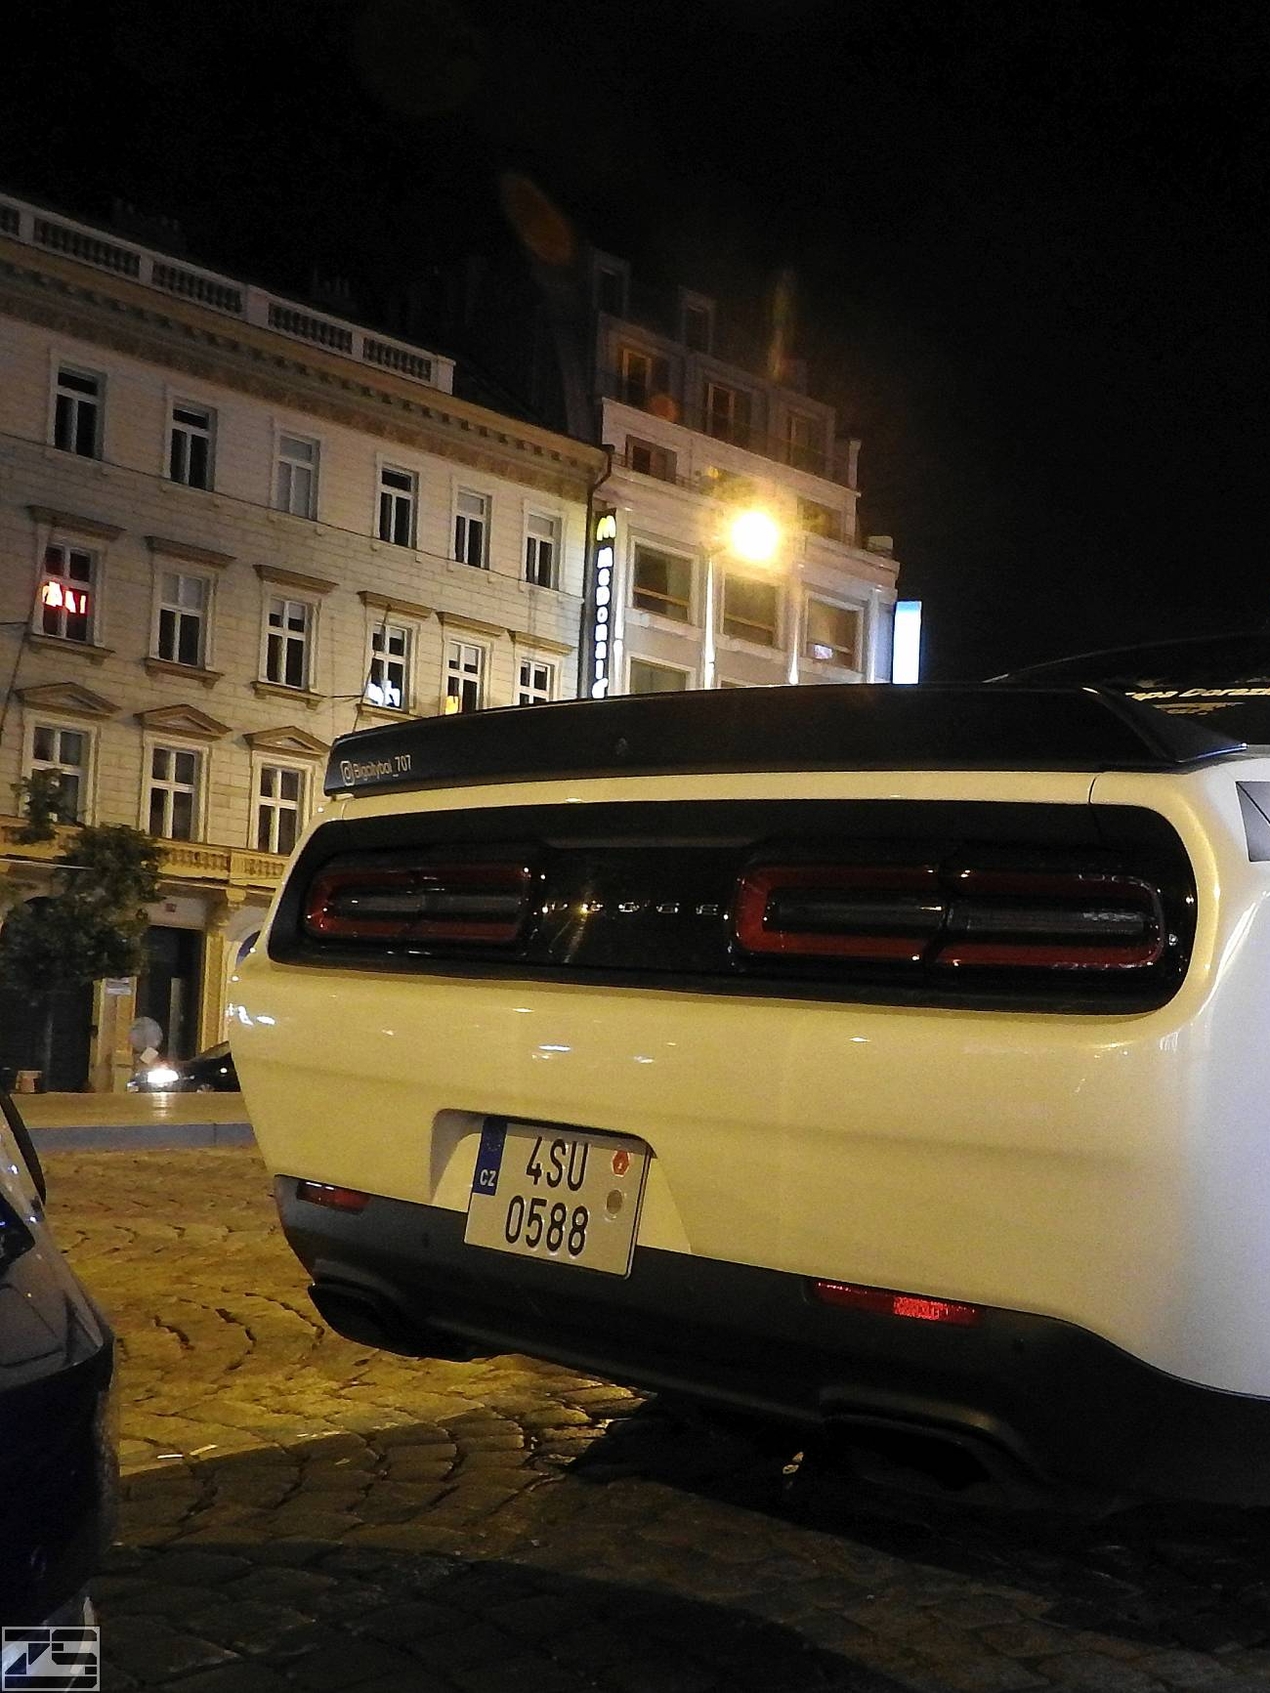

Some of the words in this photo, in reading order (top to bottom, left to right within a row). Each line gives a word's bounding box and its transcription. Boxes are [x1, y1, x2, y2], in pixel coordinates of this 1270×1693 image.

[479, 1168, 496, 1187] CZ
[525, 1136, 589, 1191] 4SU
[505, 1195, 589, 1256] 0588
